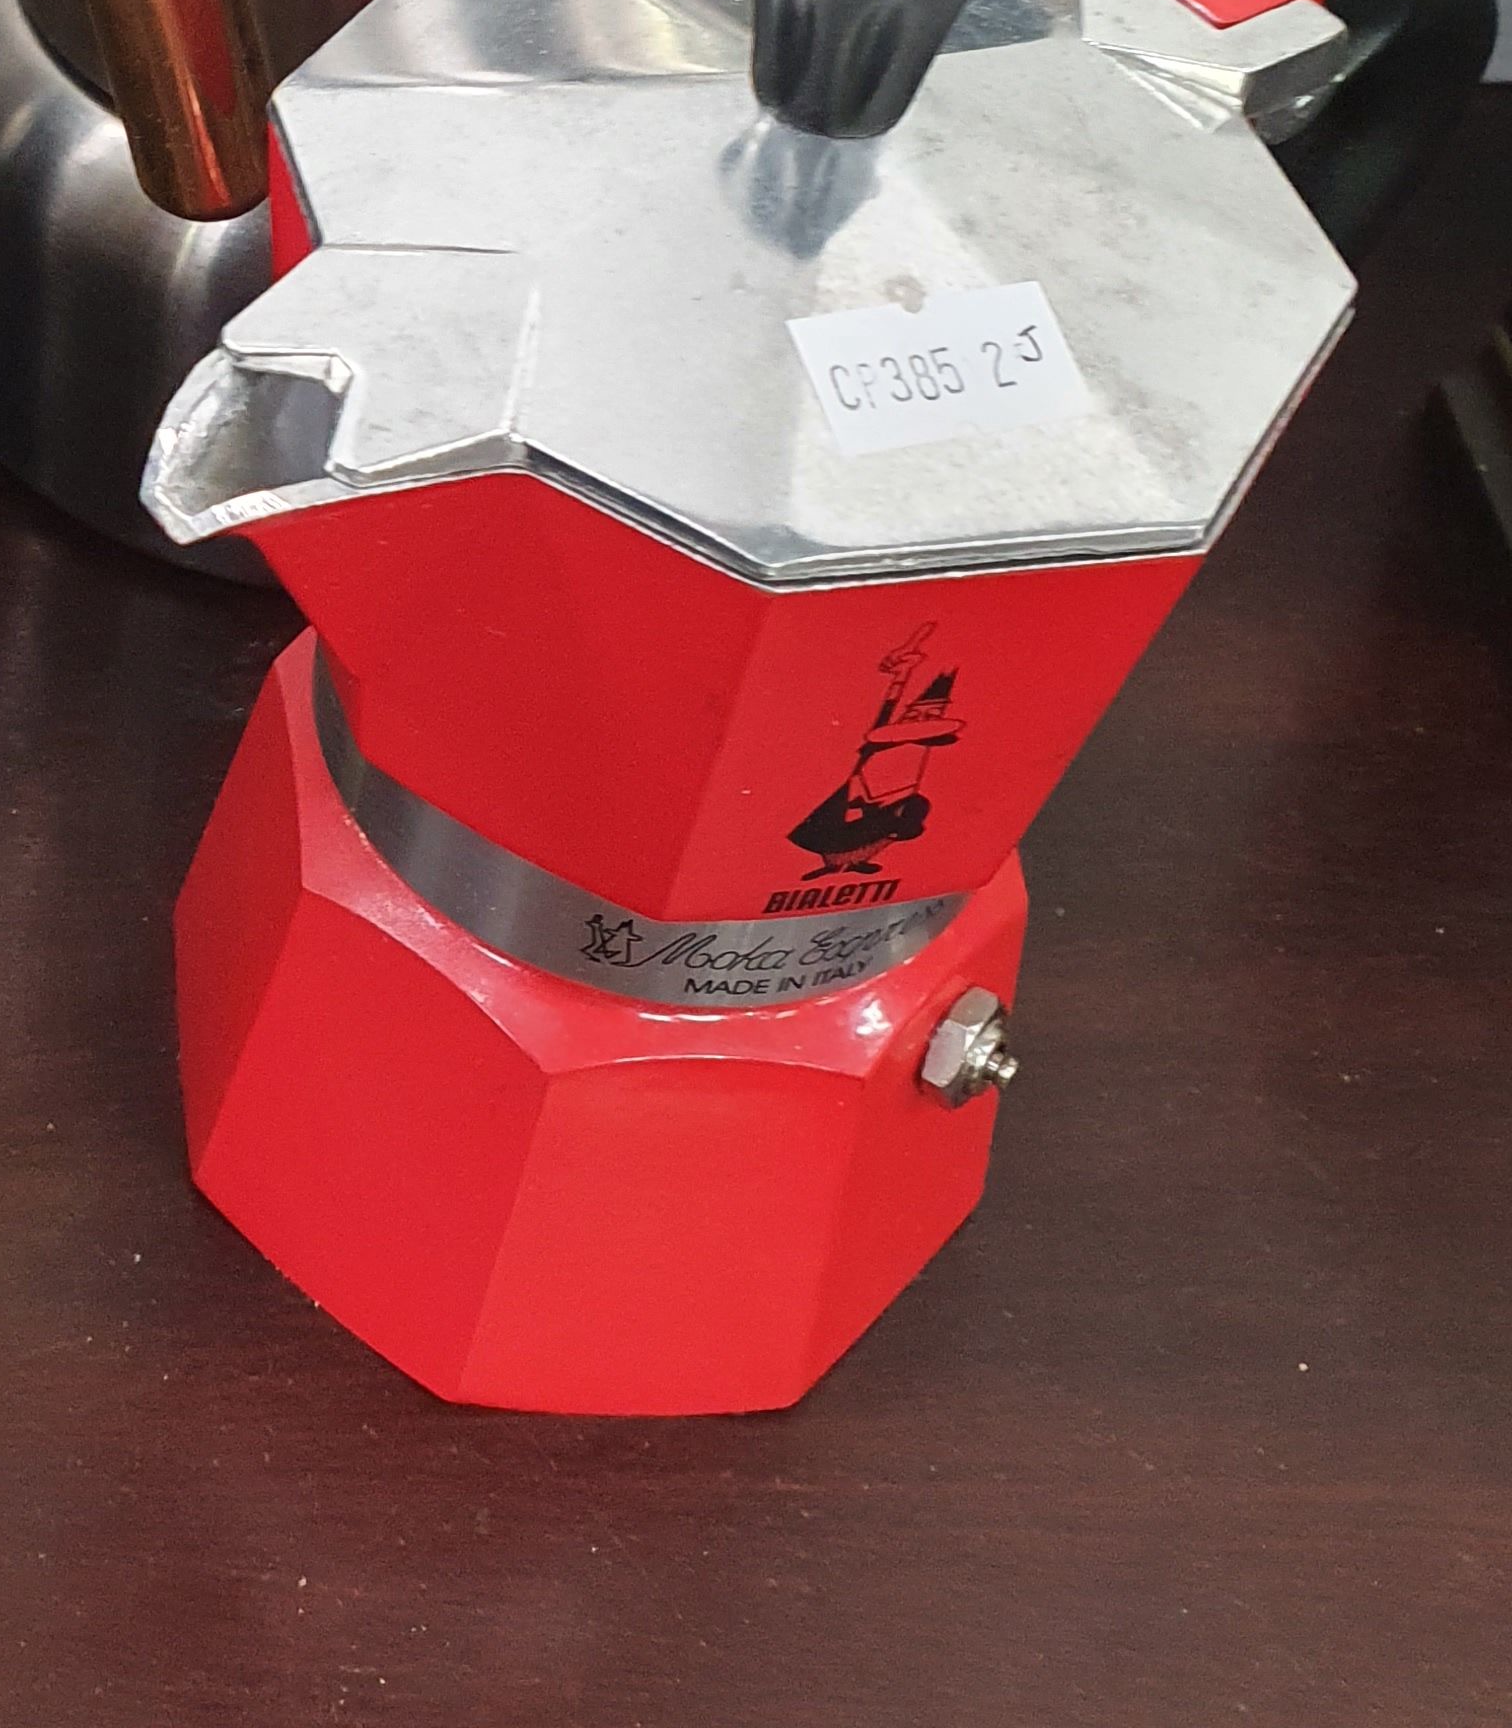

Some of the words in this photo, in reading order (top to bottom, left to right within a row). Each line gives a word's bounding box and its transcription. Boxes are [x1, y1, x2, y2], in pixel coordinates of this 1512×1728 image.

[763, 878, 901, 915] BIALETTI
[640, 931, 796, 973] Moka
[684, 976, 772, 996] MADE
[775, 974, 808, 992] IN
[811, 956, 874, 987] ITALY
